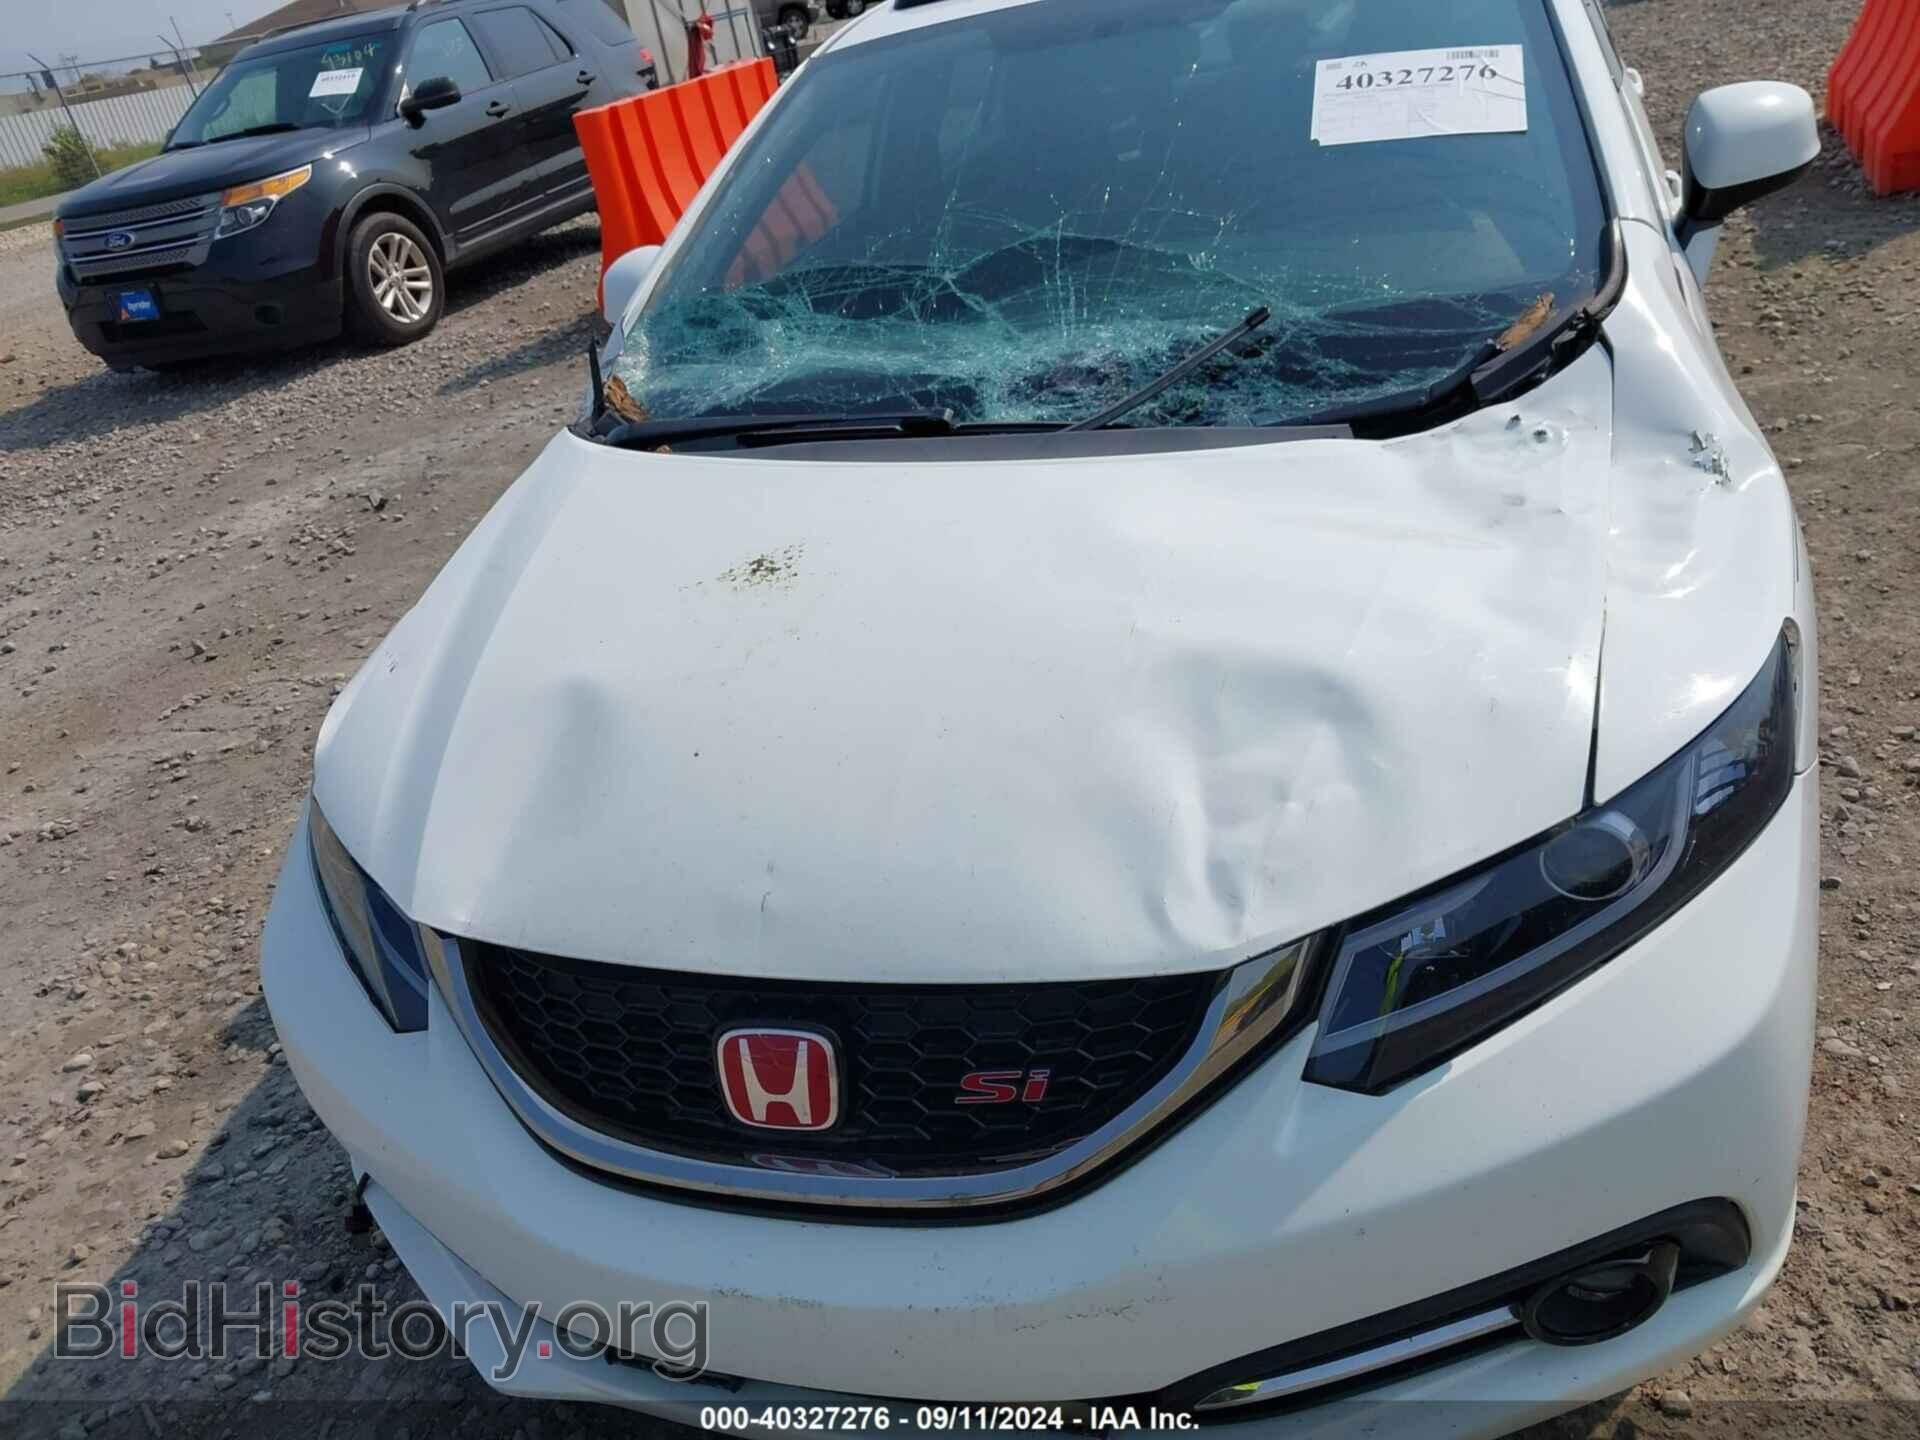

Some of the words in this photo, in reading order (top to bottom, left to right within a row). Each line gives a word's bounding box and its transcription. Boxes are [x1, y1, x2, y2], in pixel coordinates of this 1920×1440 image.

[1335, 63, 1498, 90] 40327276
[738, 1038, 813, 1125] H
[954, 1069, 1050, 1105] Si
